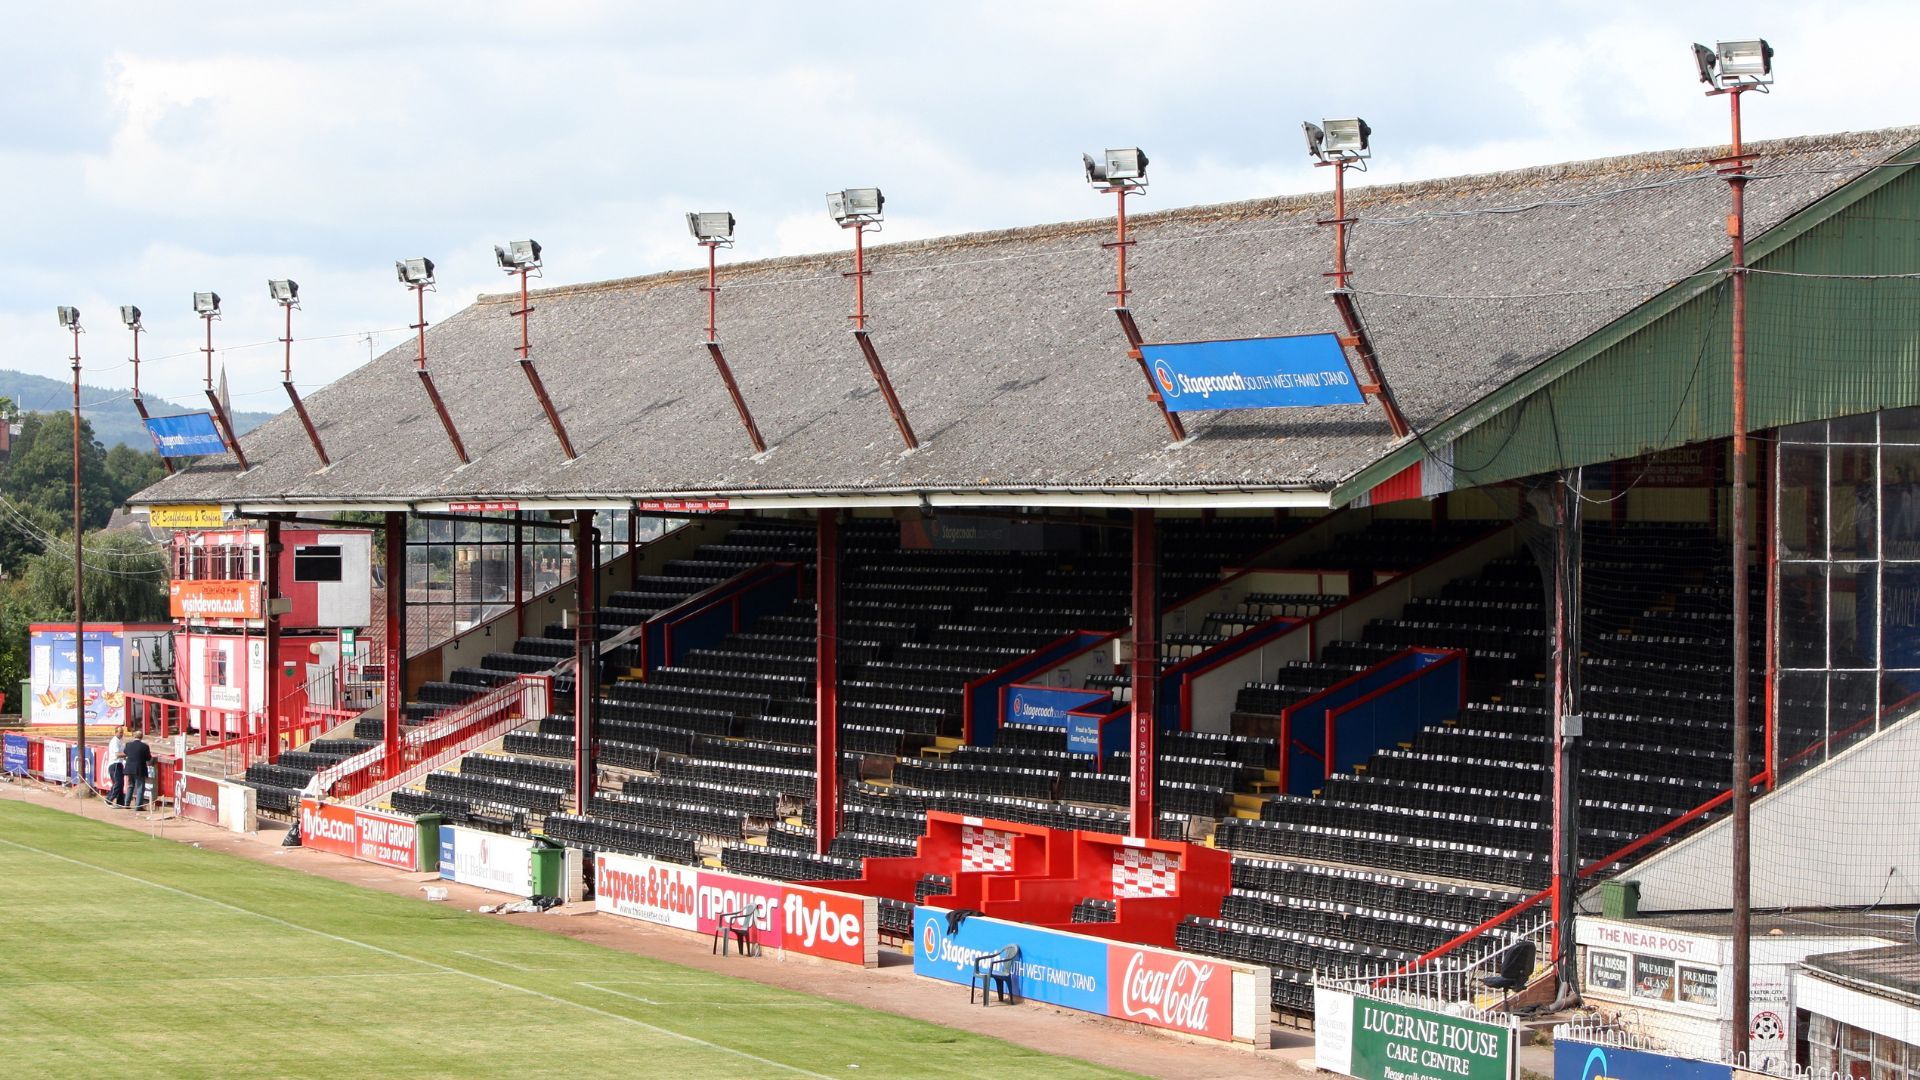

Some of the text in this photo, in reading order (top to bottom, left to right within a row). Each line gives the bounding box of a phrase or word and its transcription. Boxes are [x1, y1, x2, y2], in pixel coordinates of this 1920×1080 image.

[1178, 370, 1349, 399] Stagecoach SOUTH WEST FAMILY STAND
[182, 592, 245, 613] visitdevon.co.uk
[1023, 704, 1054, 719] Stagecoach
[1139, 718, 1147, 797] NO SMOKING
[303, 807, 355, 843] flybe.com
[362, 818, 388, 845] EXWAY
[388, 825, 414, 849] GROUP
[361, 842, 409, 863] 0871 230 0744
[597, 857, 695, 916] Express & Echo
[698, 885, 779, 932] npower
[783, 893, 860, 948] flybe
[1598, 927, 1695, 954] THE NEAR POST
[1026, 962, 1046, 982] WEST
[1047, 966, 1072, 987] FAMILY
[1071, 972, 1096, 992] STAND
[1639, 962, 1675, 977] PREMIER
[1643, 976, 1670, 989] GLASS
[1682, 970, 1718, 985] PREMIER
[1122, 951, 1214, 1031] Coca-Cola
[1363, 1007, 1440, 1045] LUCERNE
[1442, 1024, 1498, 1058] HOUSE
[1383, 1066, 1405, 1080] Please
[1386, 1042, 1470, 1076] CARE CENTRE
